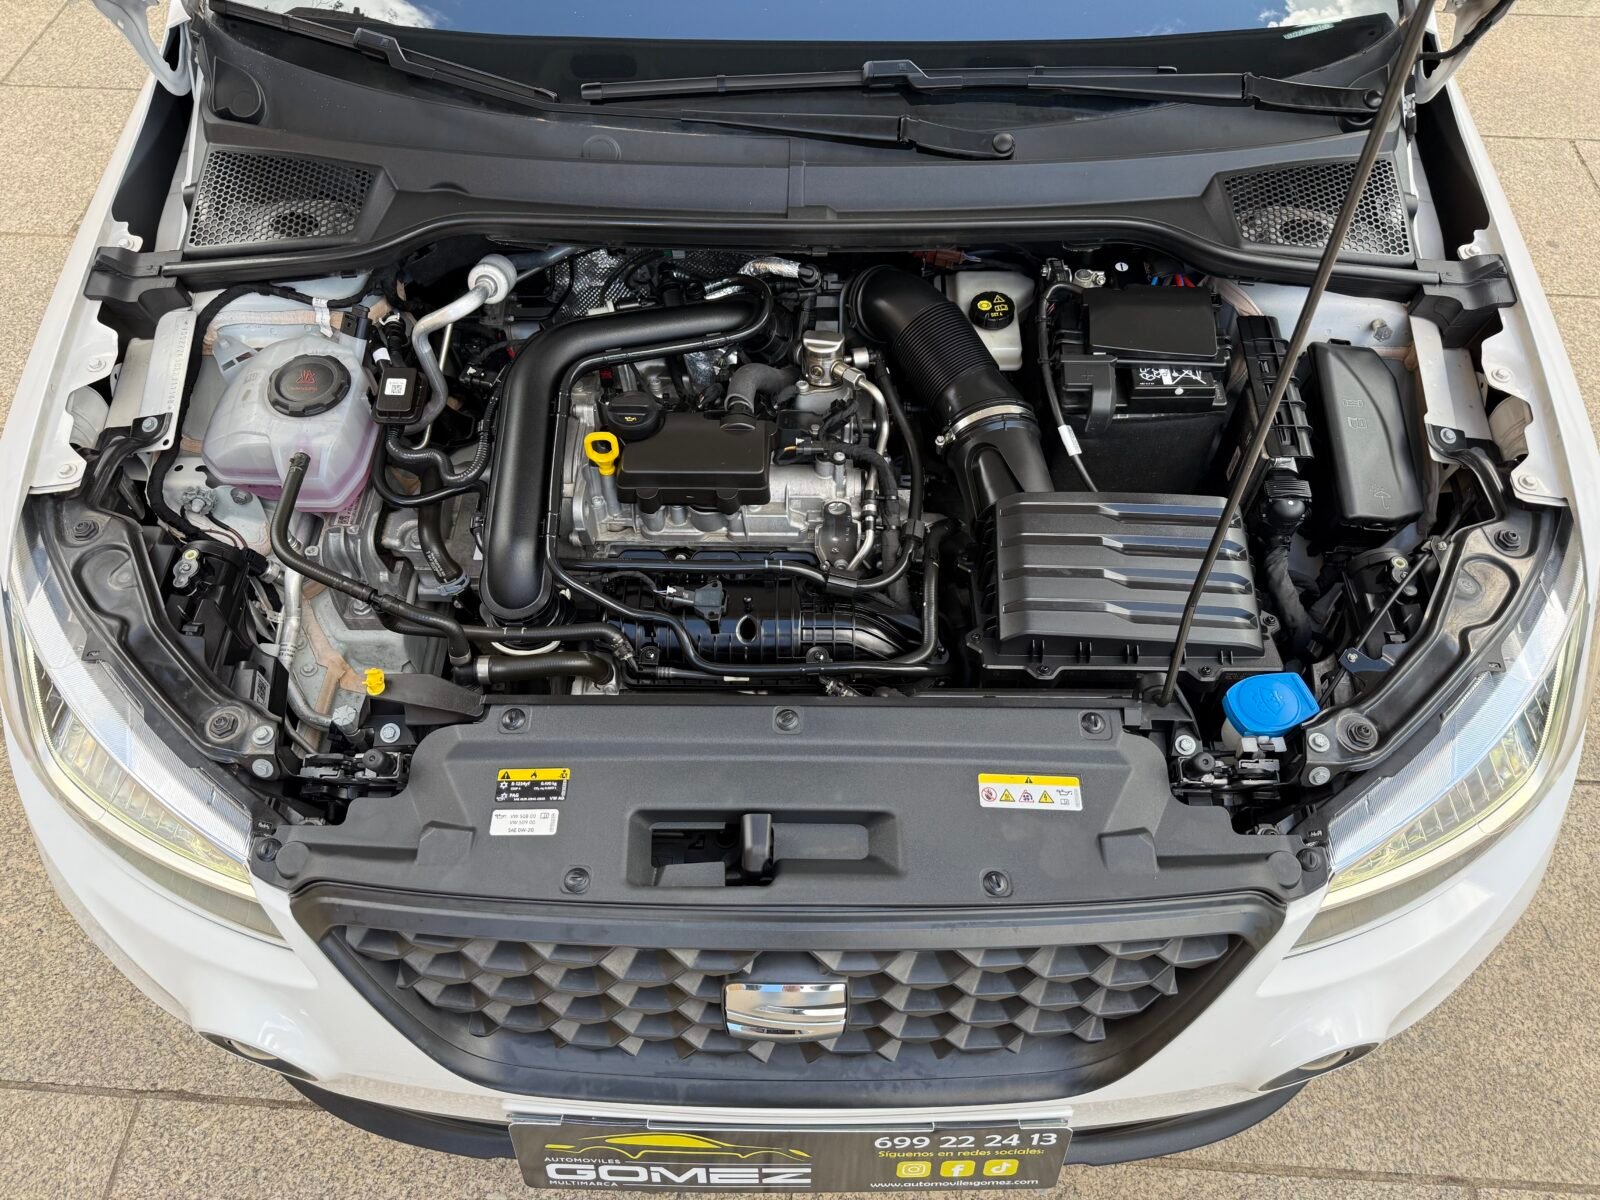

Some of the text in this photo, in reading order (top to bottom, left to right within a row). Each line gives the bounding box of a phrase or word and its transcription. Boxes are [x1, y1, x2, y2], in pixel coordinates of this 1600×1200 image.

[874, 1133, 1058, 1149] 699 22 24 13
[878, 1149, 934, 1159] Síguenos
[957, 1149, 991, 1157] redes
[994, 1148, 1045, 1156] sociales:
[544, 1156, 621, 1165] AUTOMOVILES
[545, 1163, 812, 1184] GOMEZ
[870, 1178, 1039, 1188] www.automovilesgomez.com
